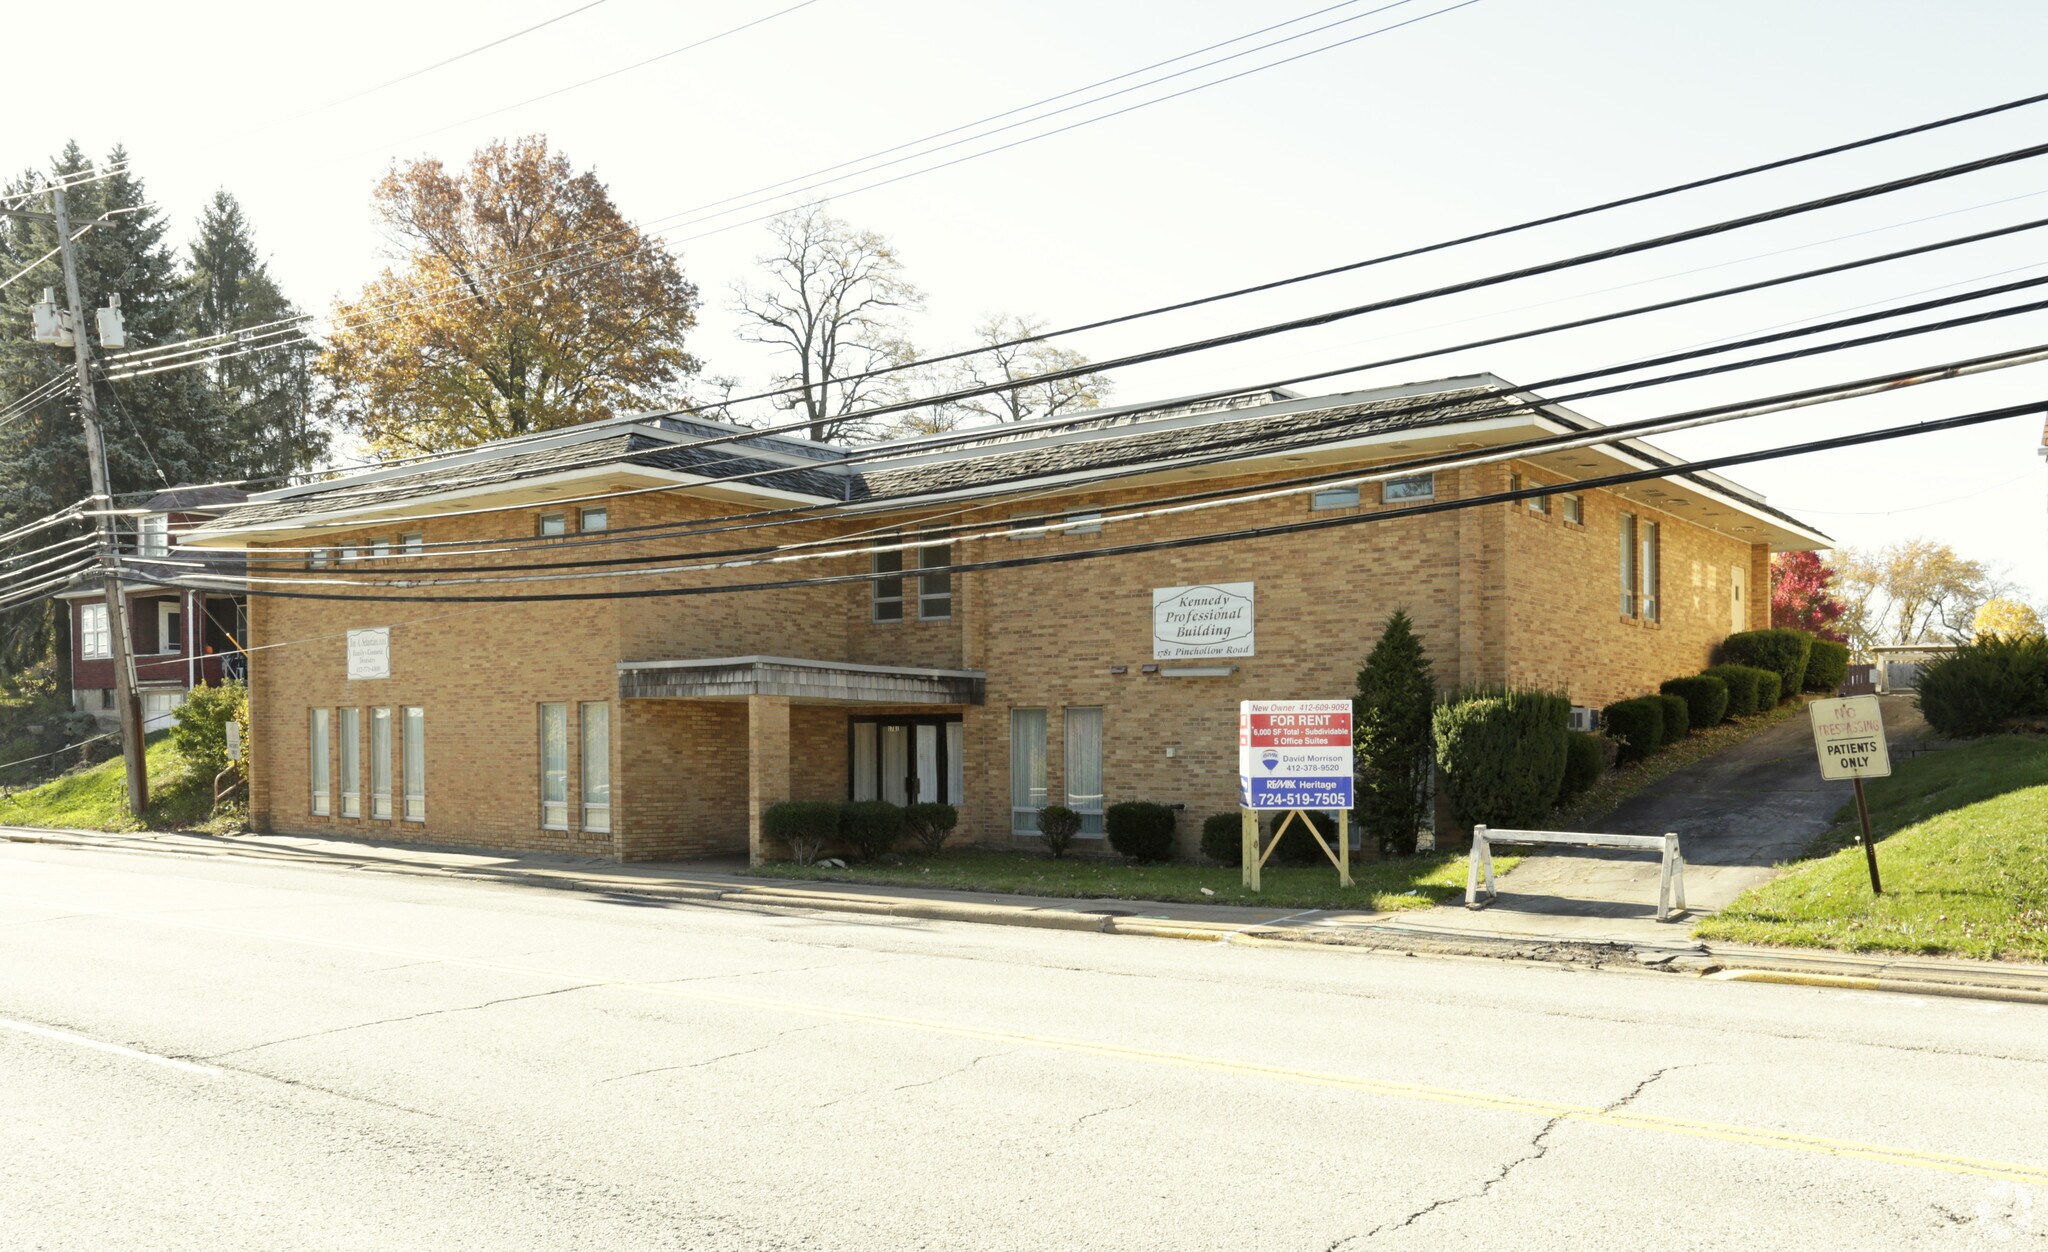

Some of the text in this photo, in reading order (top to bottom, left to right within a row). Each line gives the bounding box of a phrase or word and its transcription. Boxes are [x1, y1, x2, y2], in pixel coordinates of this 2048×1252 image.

[1180, 595, 1230, 609] Kennedy
[1165, 606, 1243, 623] Professional
[1177, 624, 1231, 640] Building
[1157, 644, 1251, 658] 1781 Pinehollow Road
[1252, 704, 1268, 712] New
[1300, 703, 1349, 711] 412-609-9092
[1270, 714, 1331, 726] FOR RENT
[1273, 728, 1282, 736] SF
[1283, 728, 1299, 736] Total
[1305, 727, 1348, 735] Subdividable
[1827, 741, 1877, 756] PATIENTS
[1307, 754, 1343, 762] Morrison
[1840, 757, 1869, 768] ONLY
[1286, 764, 1340, 772] 412-378-9520
[1266, 780, 1337, 791] RE/MAX Heritage
[1258, 792, 1346, 806] 724-519-7505
